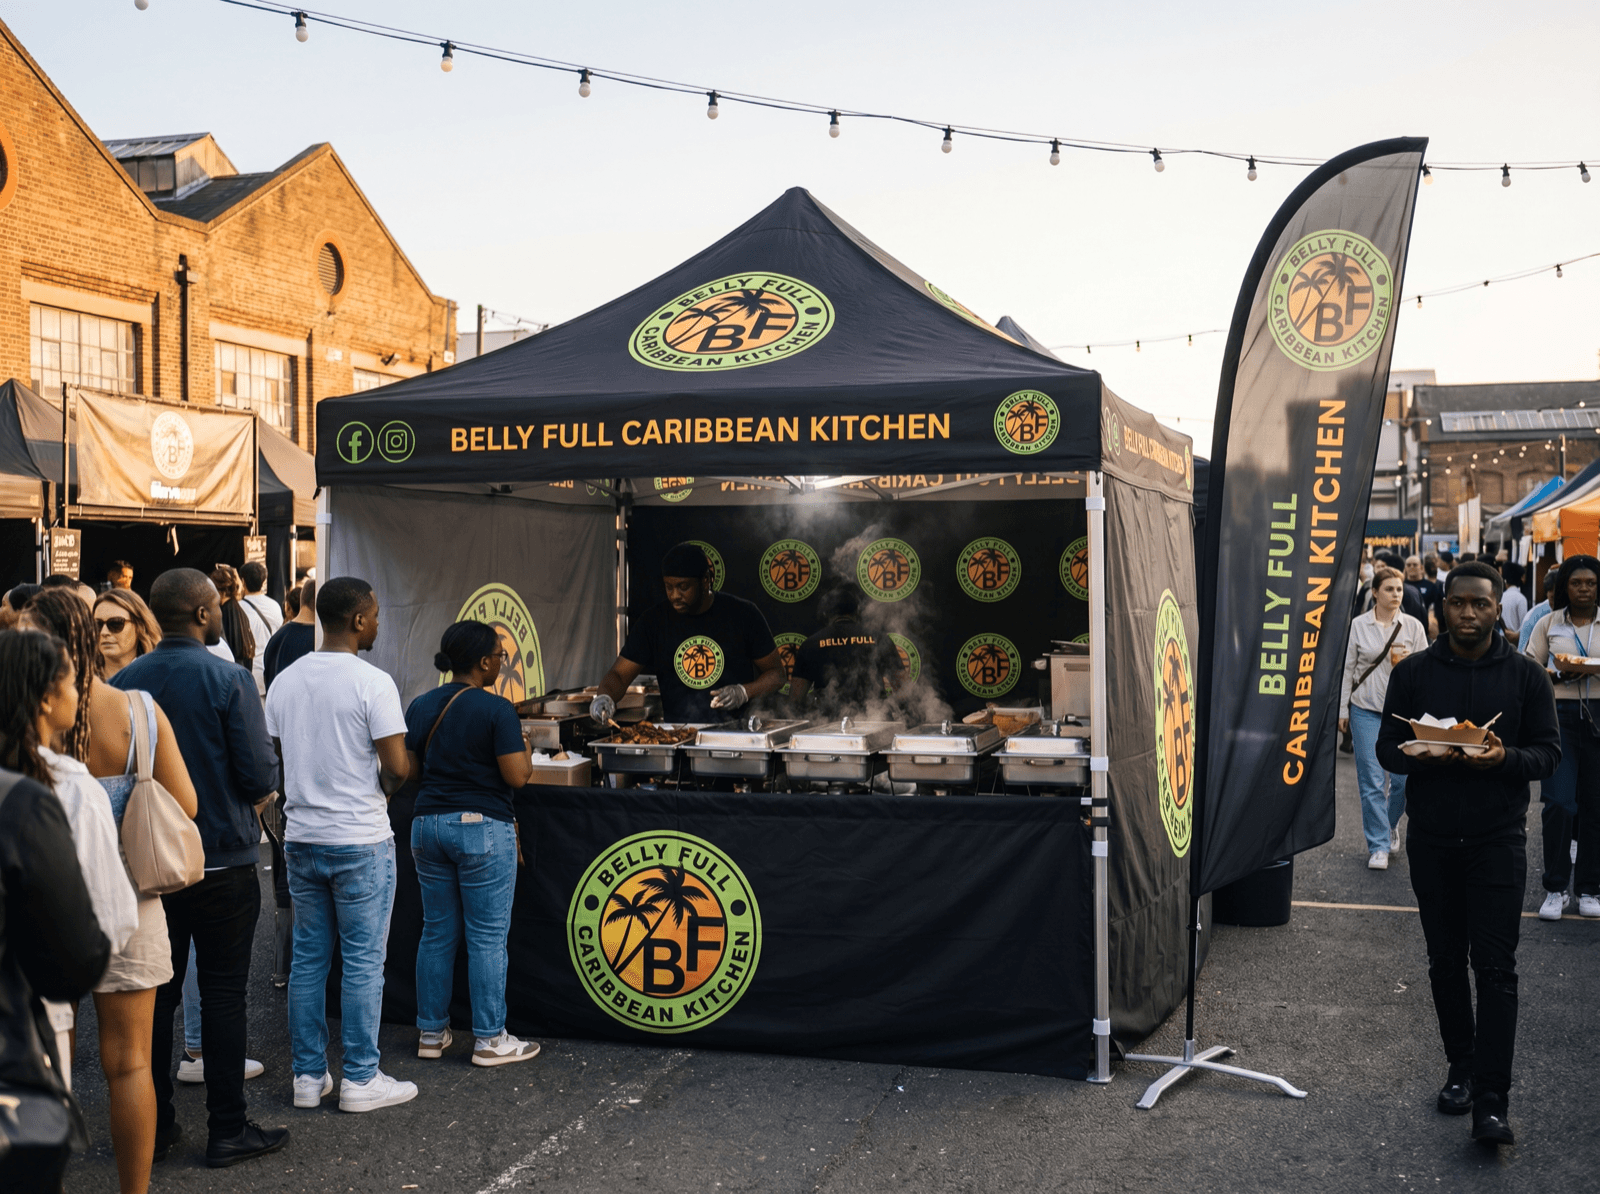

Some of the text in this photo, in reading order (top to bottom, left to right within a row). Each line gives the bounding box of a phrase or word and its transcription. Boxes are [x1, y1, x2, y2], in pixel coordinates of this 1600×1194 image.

[1289, 237, 1377, 271] BELLY FULL
[676, 277, 813, 307] BELLY FULL
[641, 321, 820, 366] CARIBBEAN KITCHEN
[1273, 294, 1389, 364] CARIBBEAN KITCHEN
[451, 412, 950, 452] BELLY FULL CARIBBEAN KITCHEN
[1258, 493, 1298, 696] BELLY FULL
[1282, 399, 1346, 786] CARIBBEAN KITCHEN
[819, 635, 876, 648] BELLY FULL
[597, 843, 731, 892] BELLY FULL
[578, 925, 750, 1023] CARIBBEAN KITCHEN
